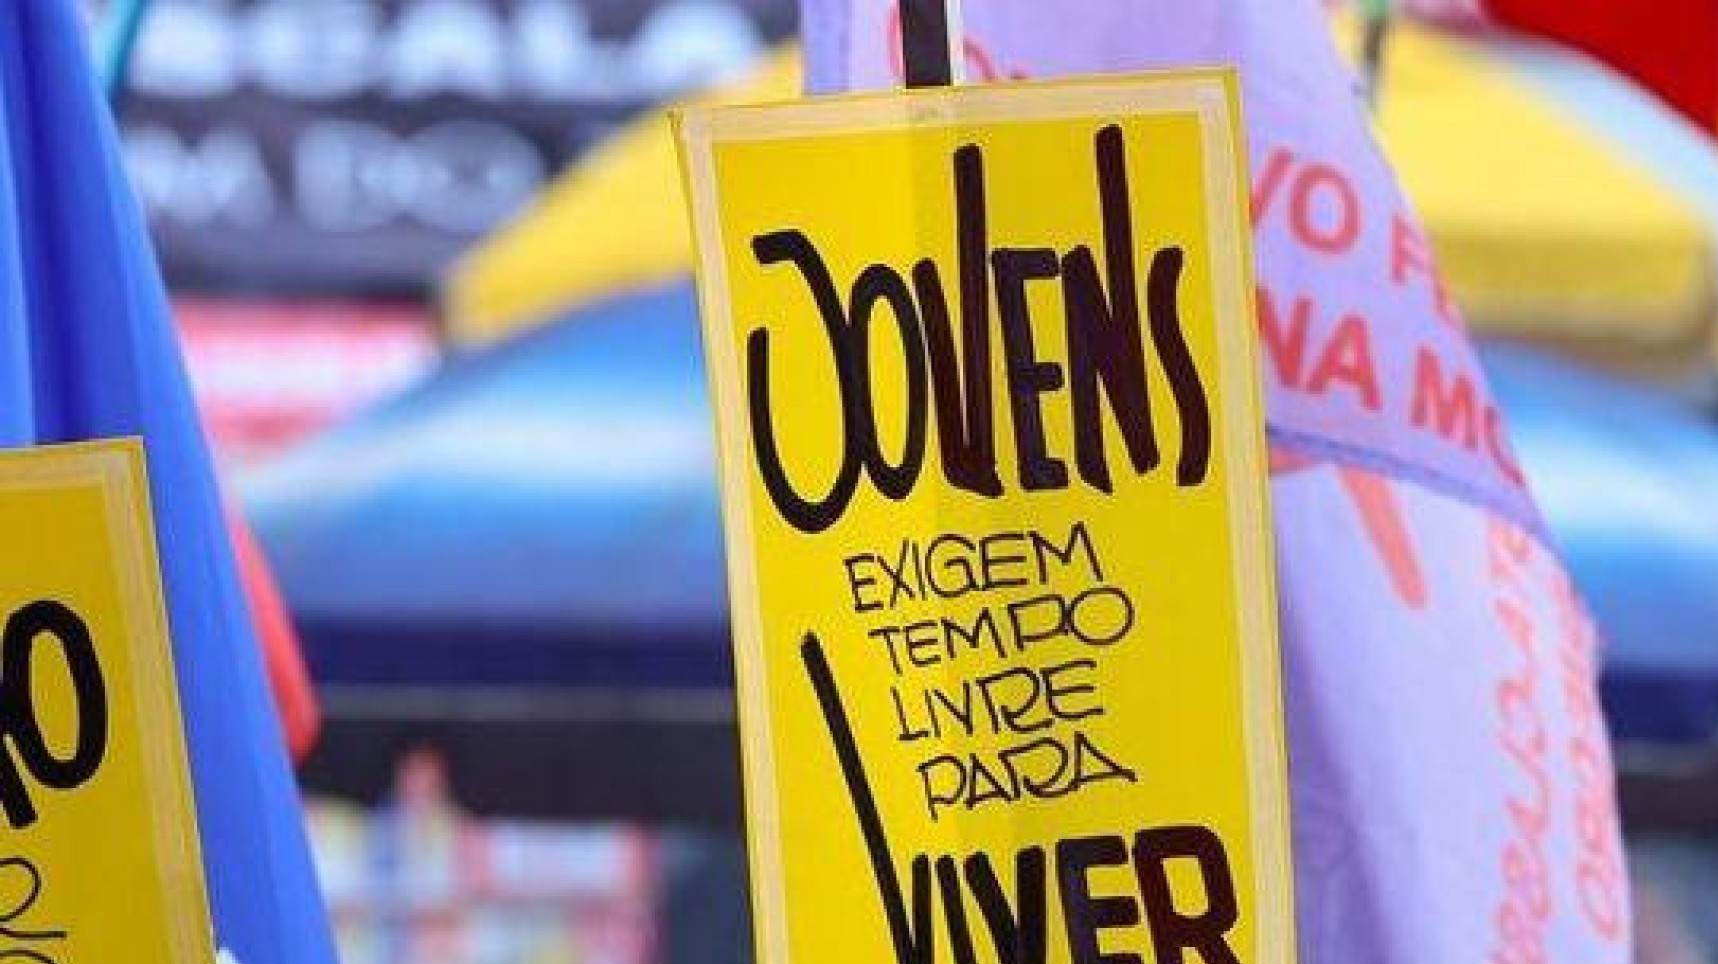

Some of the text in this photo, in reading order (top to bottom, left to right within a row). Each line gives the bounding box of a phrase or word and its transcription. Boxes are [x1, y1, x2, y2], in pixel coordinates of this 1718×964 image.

[746, 123, 1213, 534] JOVENS
[843, 520, 1106, 614] EXIGEM
[867, 585, 1136, 675] TEMPO
[890, 658, 1105, 743] LIVRE
[915, 730, 1140, 821] PARA
